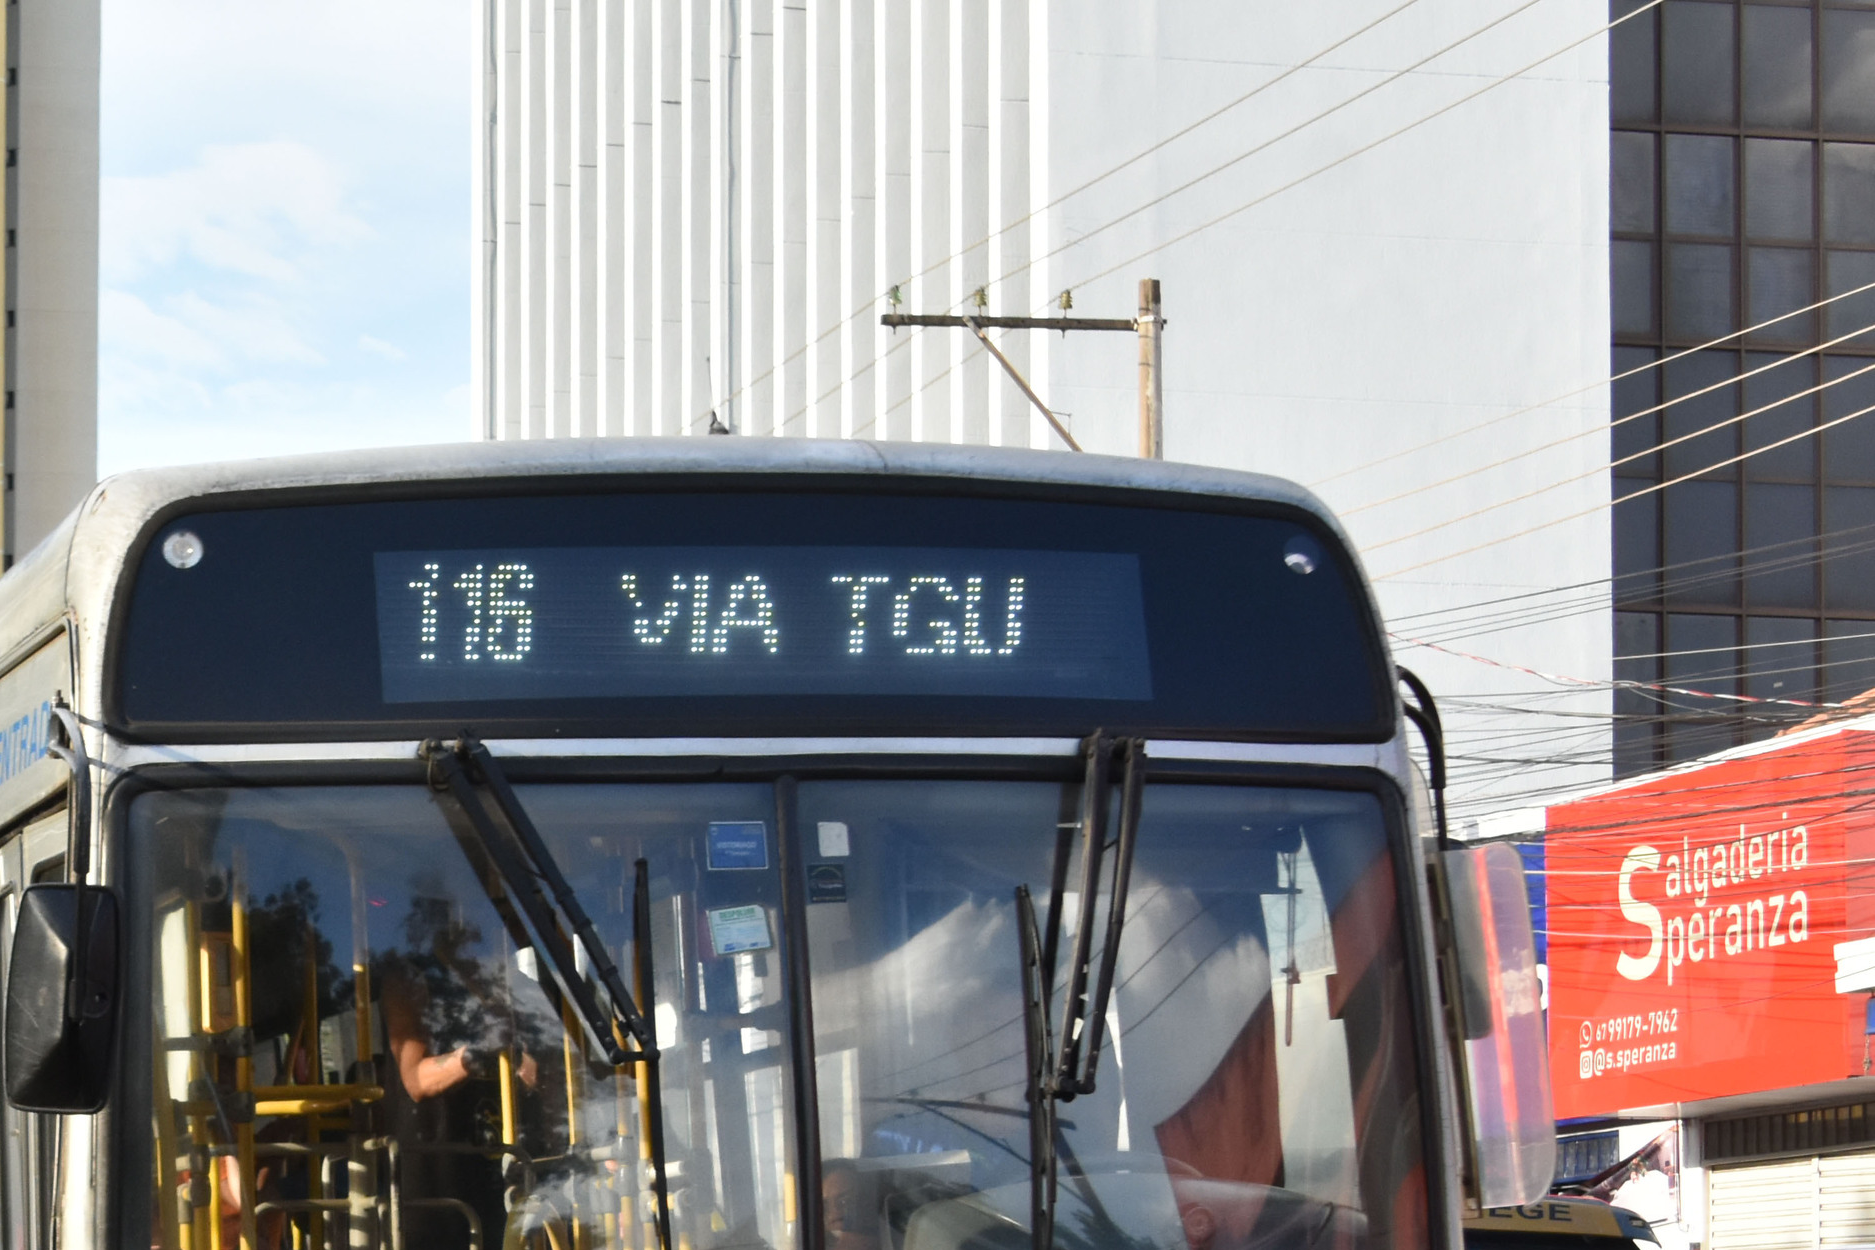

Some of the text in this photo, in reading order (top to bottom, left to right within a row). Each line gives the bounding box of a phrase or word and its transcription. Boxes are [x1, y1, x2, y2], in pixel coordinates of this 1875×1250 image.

[408, 563, 1026, 661] 116 VIA TGU
[1594, 1042, 1676, 1076] @s.speranza
[1488, 1203, 1573, 1222] EGE
